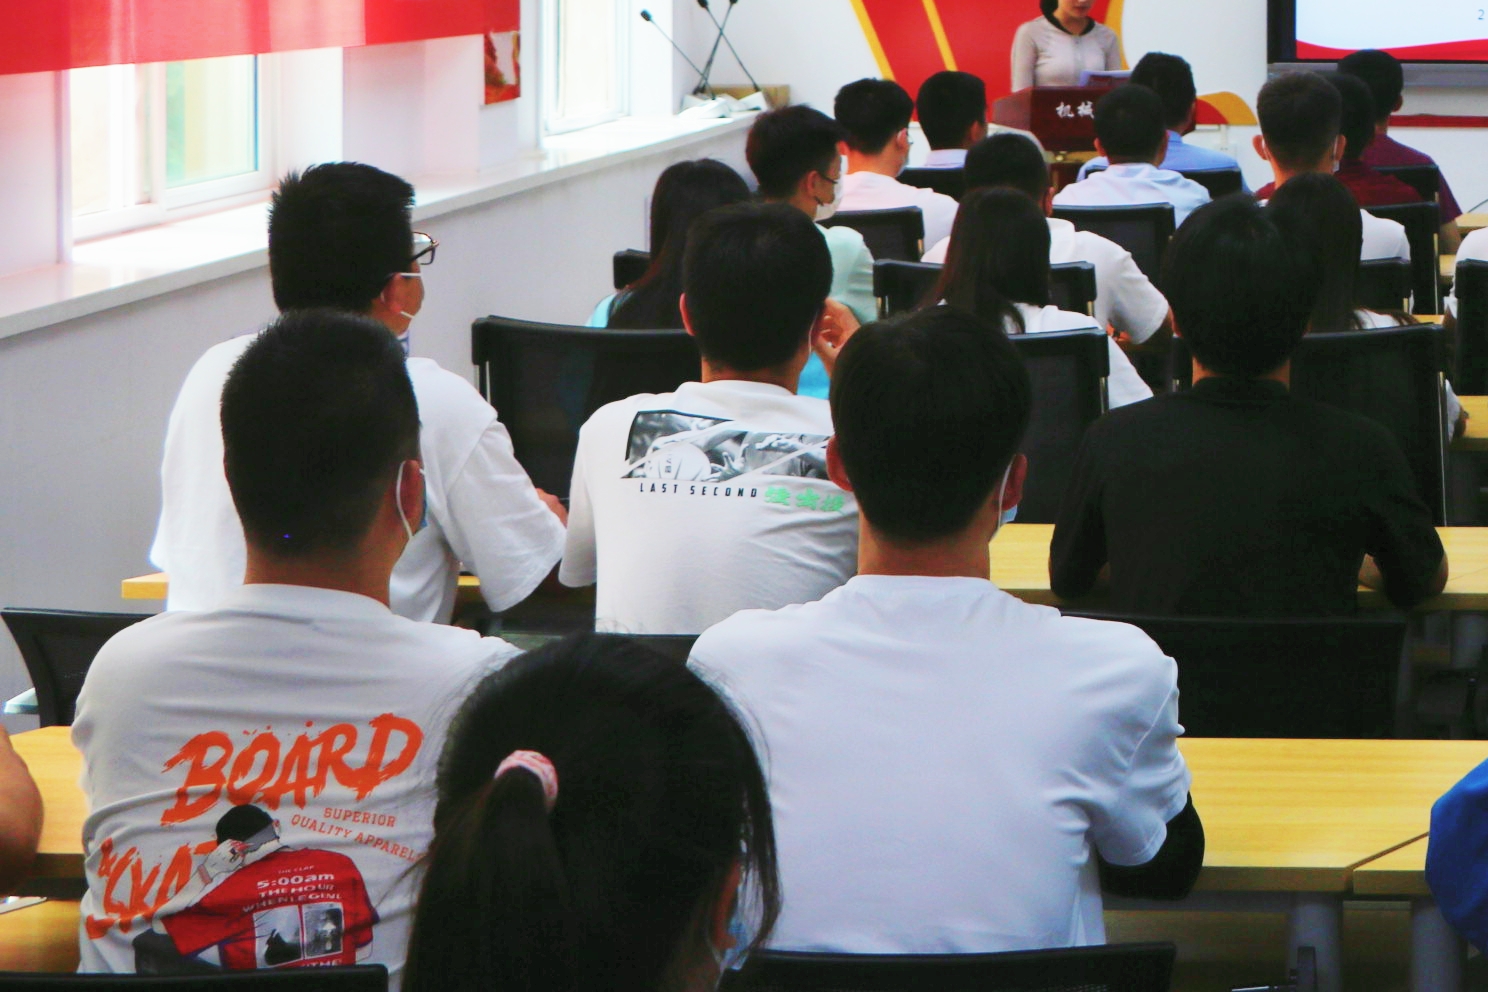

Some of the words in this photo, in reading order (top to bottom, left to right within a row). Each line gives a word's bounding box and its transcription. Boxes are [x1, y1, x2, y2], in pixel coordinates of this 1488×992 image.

[1055, 101, 1095, 120] 机械
[639, 482, 678, 494] LAST
[689, 485, 758, 498] SECOND
[160, 712, 424, 826] BOARD
[291, 814, 353, 839] QUALITY
[323, 807, 396, 828] SUPERIOR
[257, 873, 335, 889] 5:00am
